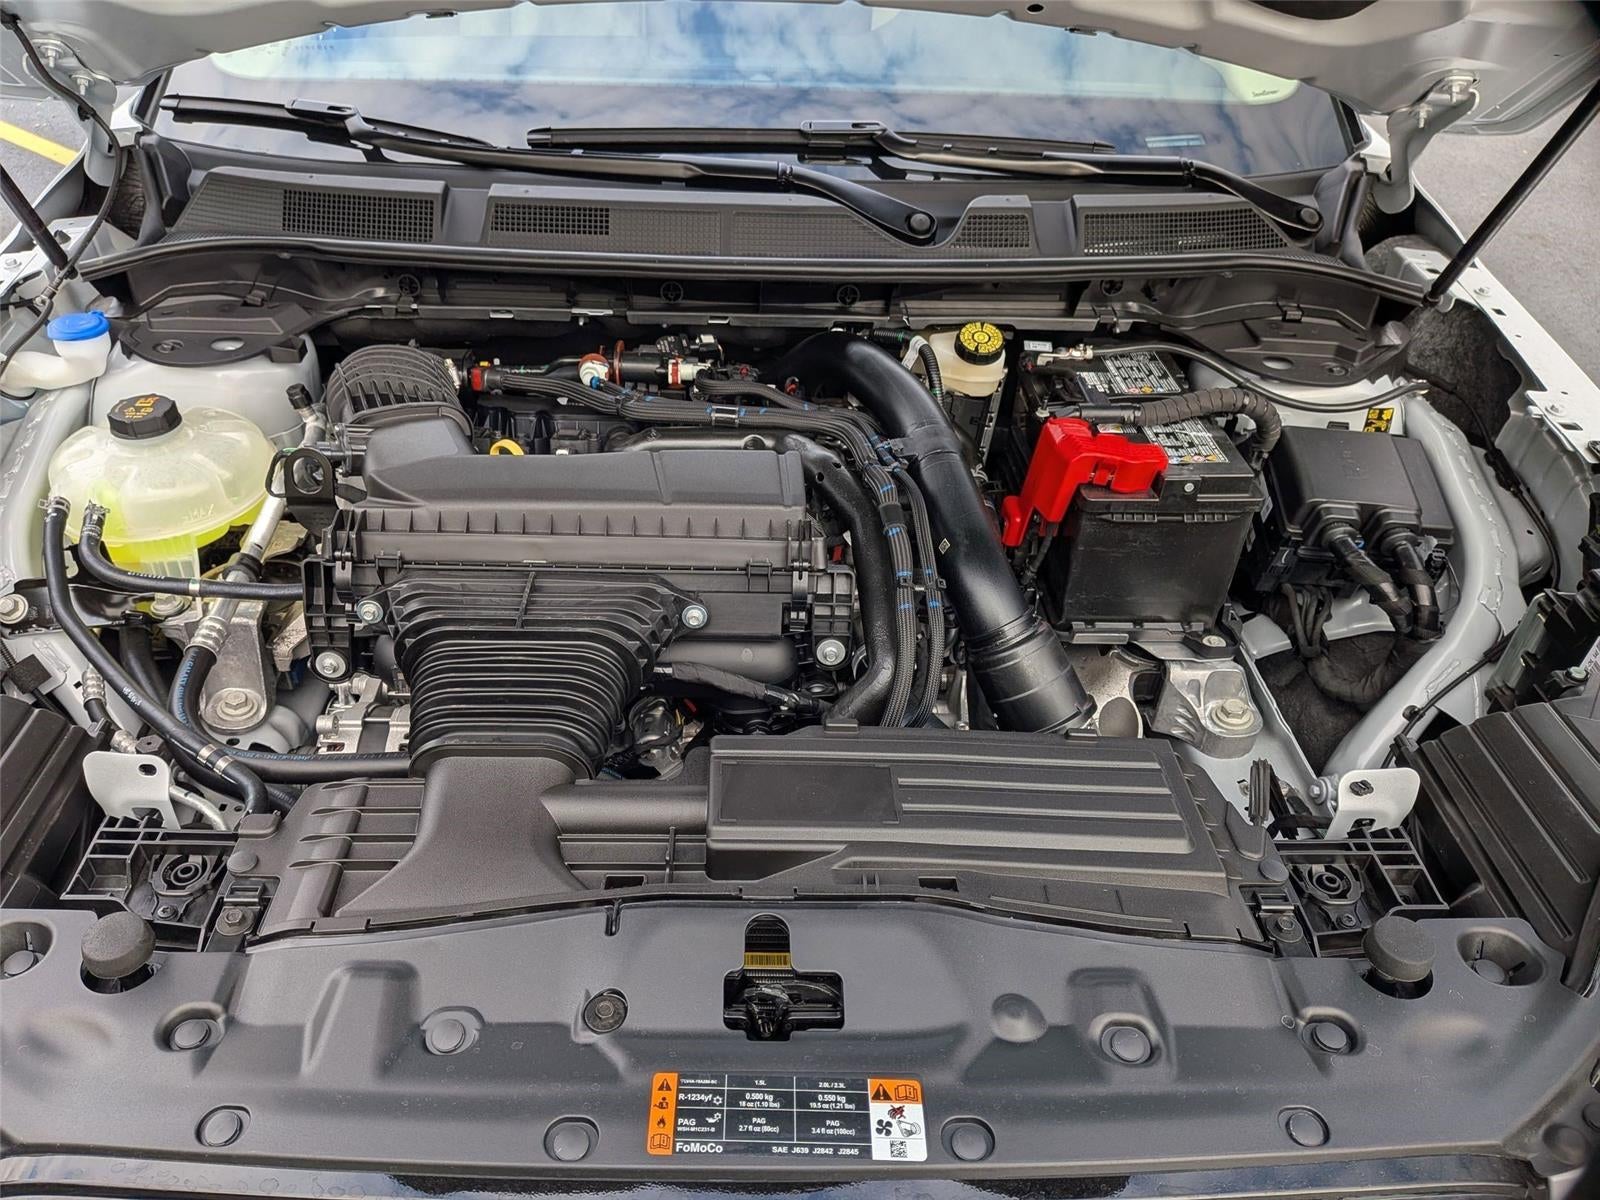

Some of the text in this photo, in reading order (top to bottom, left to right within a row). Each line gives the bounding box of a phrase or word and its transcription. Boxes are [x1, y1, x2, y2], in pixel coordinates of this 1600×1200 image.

[678, 1093, 712, 1102] R-1234yf
[745, 1092, 774, 1102] 0.500 kg
[818, 1094, 846, 1103] 0.550 kg
[677, 1118, 696, 1126] PAG
[675, 1142, 723, 1153] FoMoCo
[812, 1147, 834, 1155] J2842
